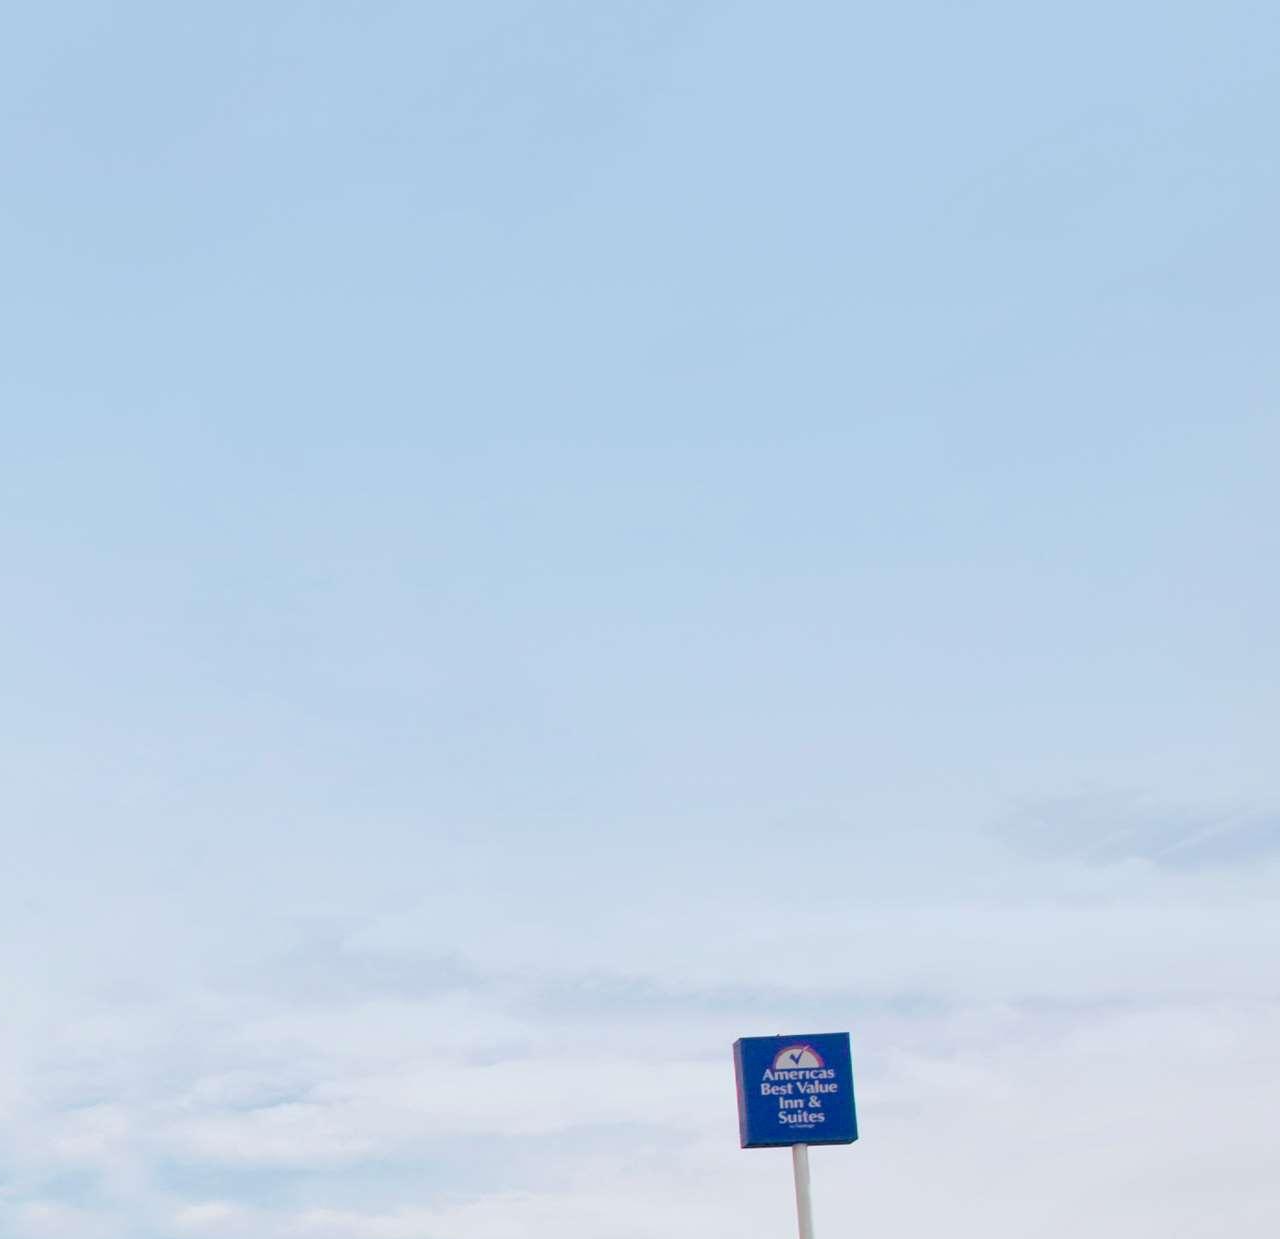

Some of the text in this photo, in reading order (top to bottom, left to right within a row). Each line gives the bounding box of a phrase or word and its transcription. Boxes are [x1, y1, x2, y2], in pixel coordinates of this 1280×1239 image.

[762, 1069, 835, 1081] Americas
[761, 1080, 838, 1096] Best Value
[779, 1095, 822, 1109] Inn &
[778, 1110, 825, 1124] Suites
